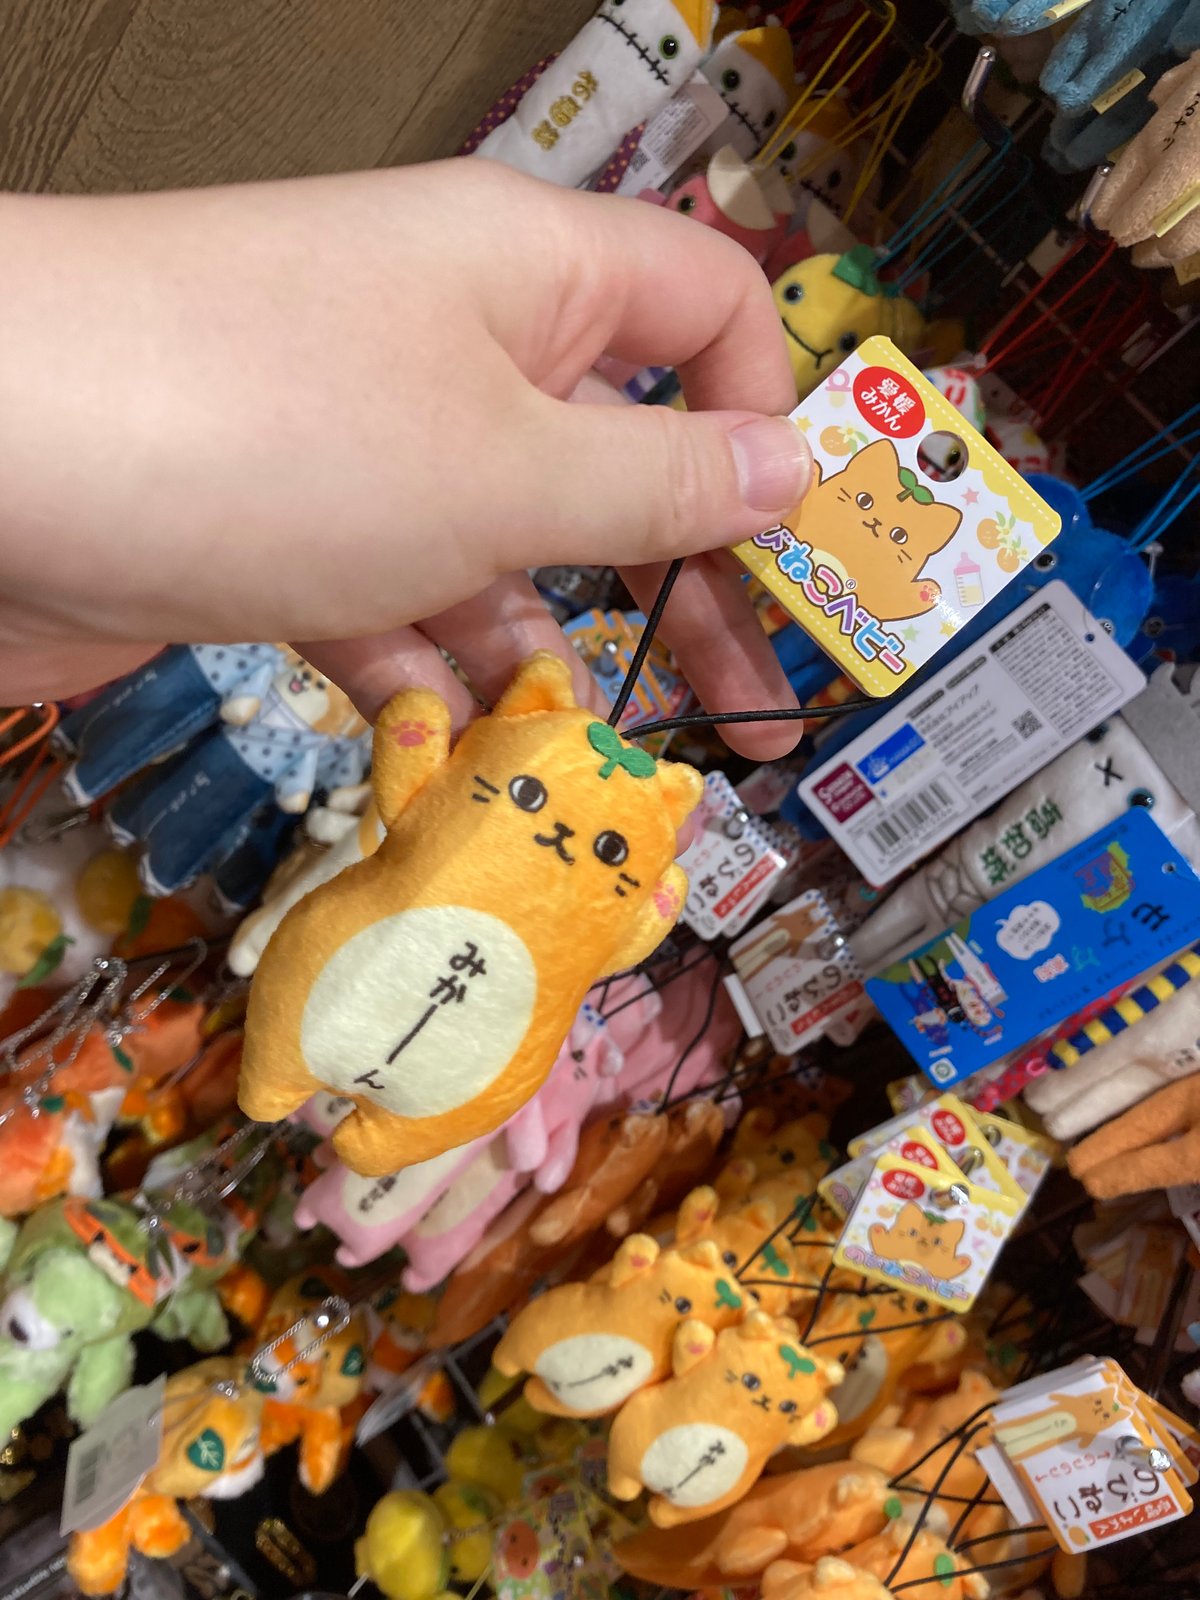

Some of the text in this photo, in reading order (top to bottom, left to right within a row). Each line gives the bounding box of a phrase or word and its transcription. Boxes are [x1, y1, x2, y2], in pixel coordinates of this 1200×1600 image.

[1163, 91, 1200, 151] るヤツ
[860, 387, 902, 432] みかん
[876, 376, 916, 416] 愛媛
[752, 523, 907, 675] びねこベビー
[685, 842, 756, 916] のびねこ
[766, 964, 842, 1026] のびねこ
[1053, 1467, 1160, 1522] のびねこ
[1097, 1498, 1174, 1536] 愛媛いよかん
